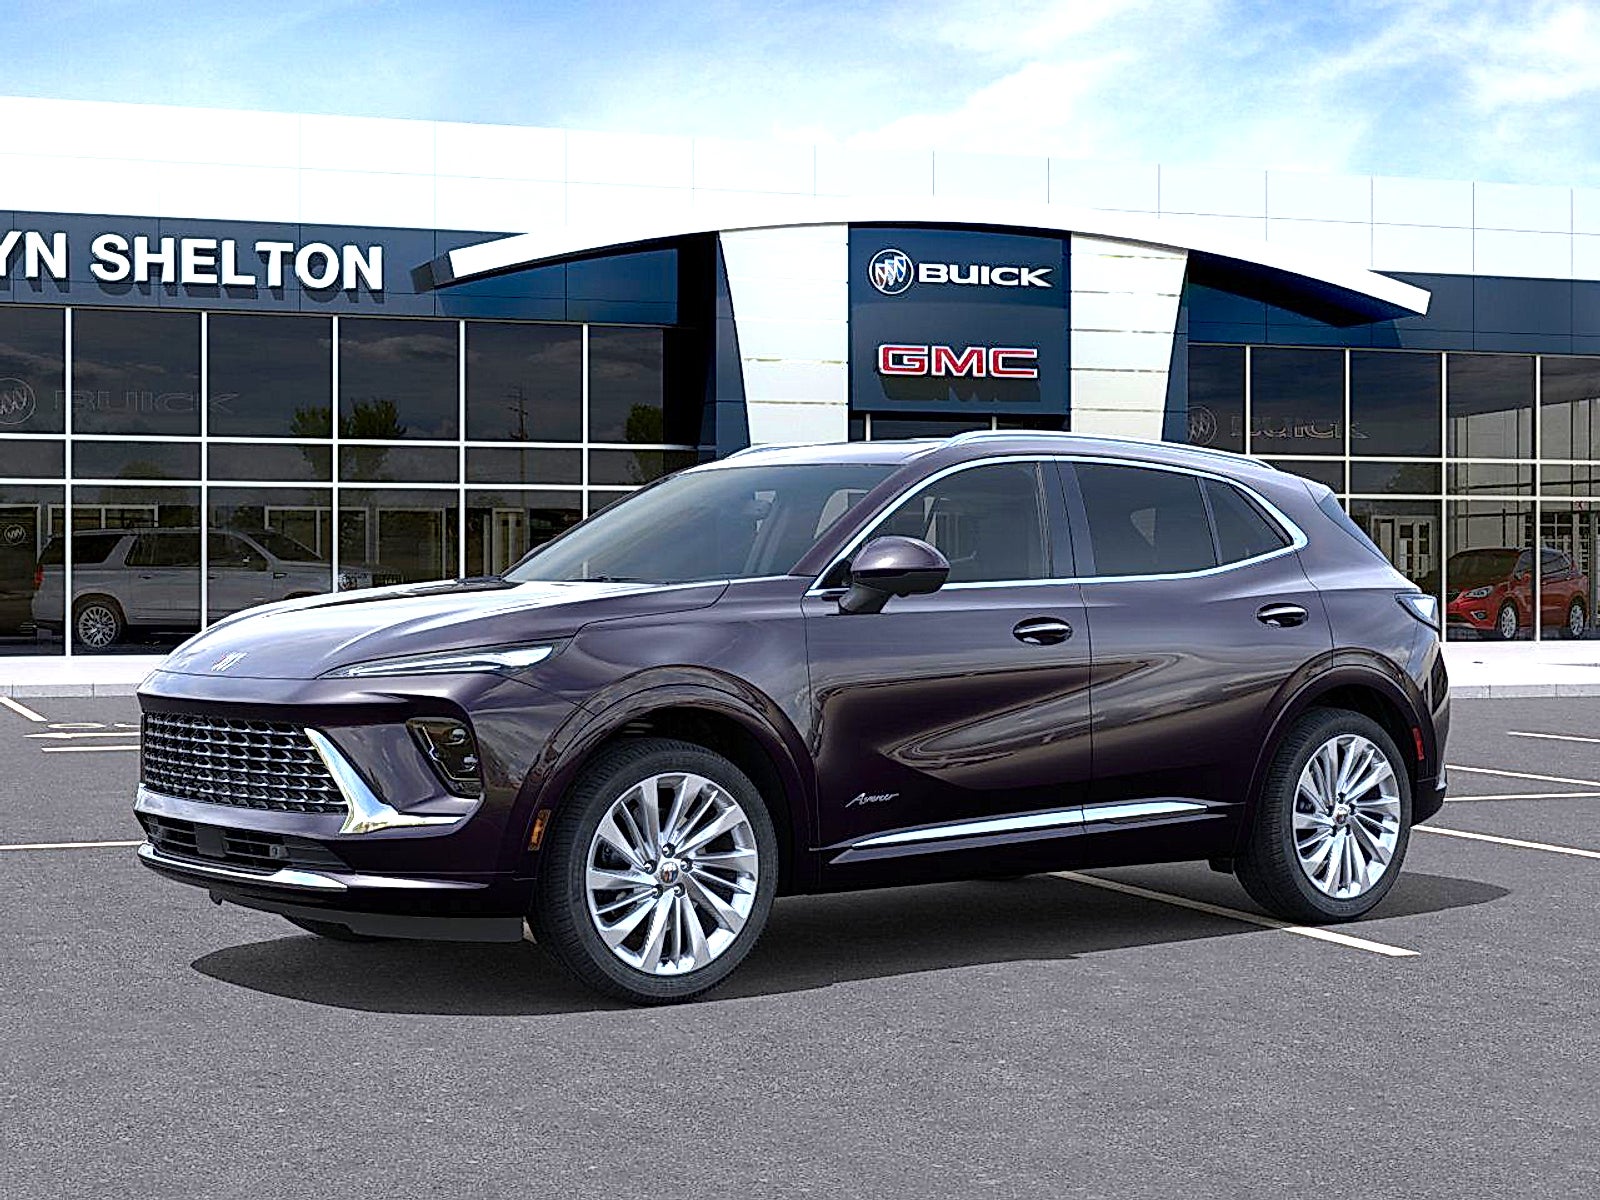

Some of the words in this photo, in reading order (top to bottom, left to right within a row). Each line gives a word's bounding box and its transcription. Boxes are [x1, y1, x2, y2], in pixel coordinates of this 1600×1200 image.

[90, 234, 384, 290] SHELTON
[918, 263, 1053, 288] BUICK
[877, 345, 1040, 379] GMC
